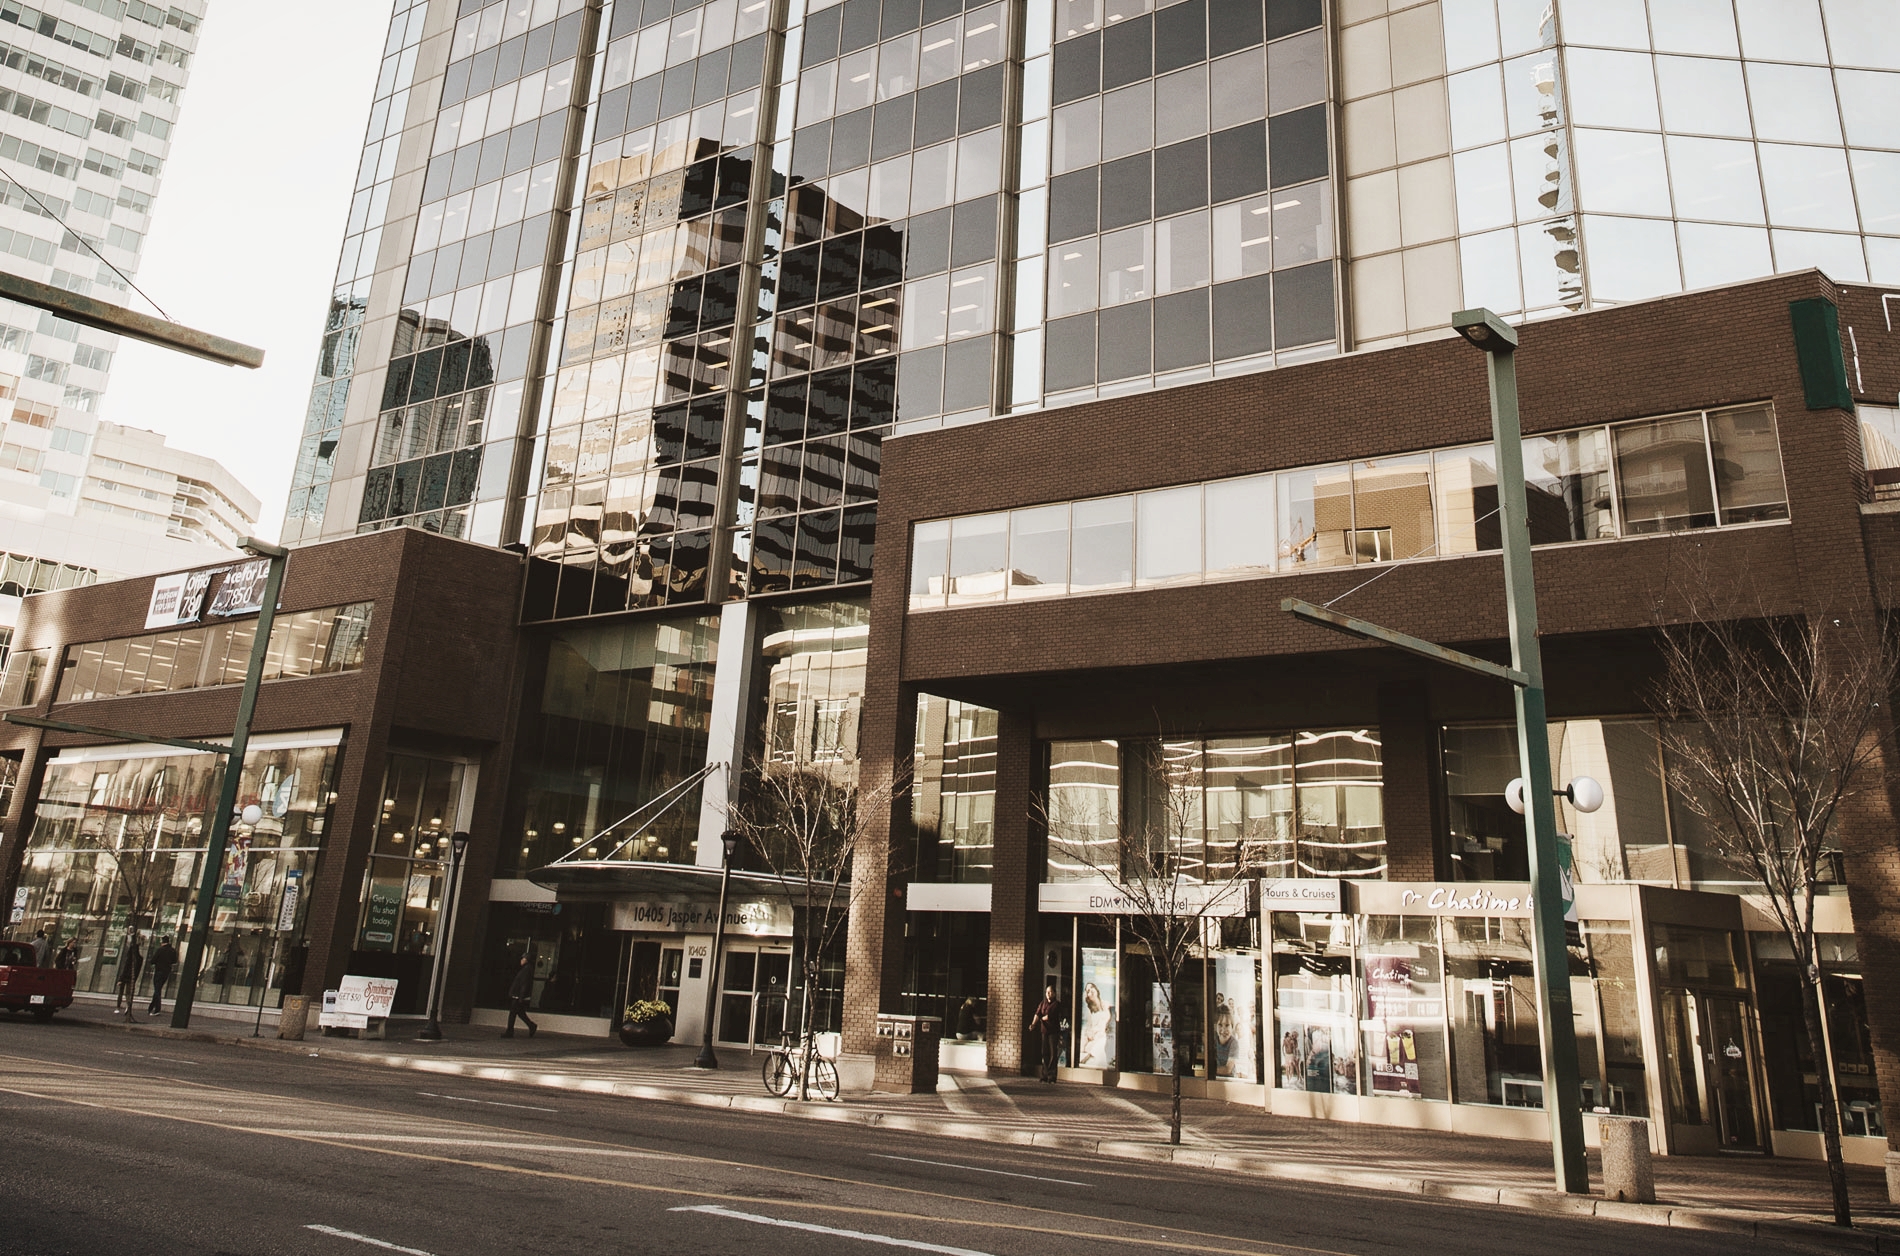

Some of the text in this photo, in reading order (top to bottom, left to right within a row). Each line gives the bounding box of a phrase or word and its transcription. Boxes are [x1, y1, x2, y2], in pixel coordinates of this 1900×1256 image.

[1265, 887, 1336, 899] Tours & Cruises
[372, 894, 400, 905] Get your
[1427, 888, 1520, 911] Chatime
[372, 905, 396, 915] flu shot
[633, 906, 748, 927] 10405 Jasper Avnue
[688, 945, 707, 957] 10405
[1372, 968, 1409, 980] Chatime
